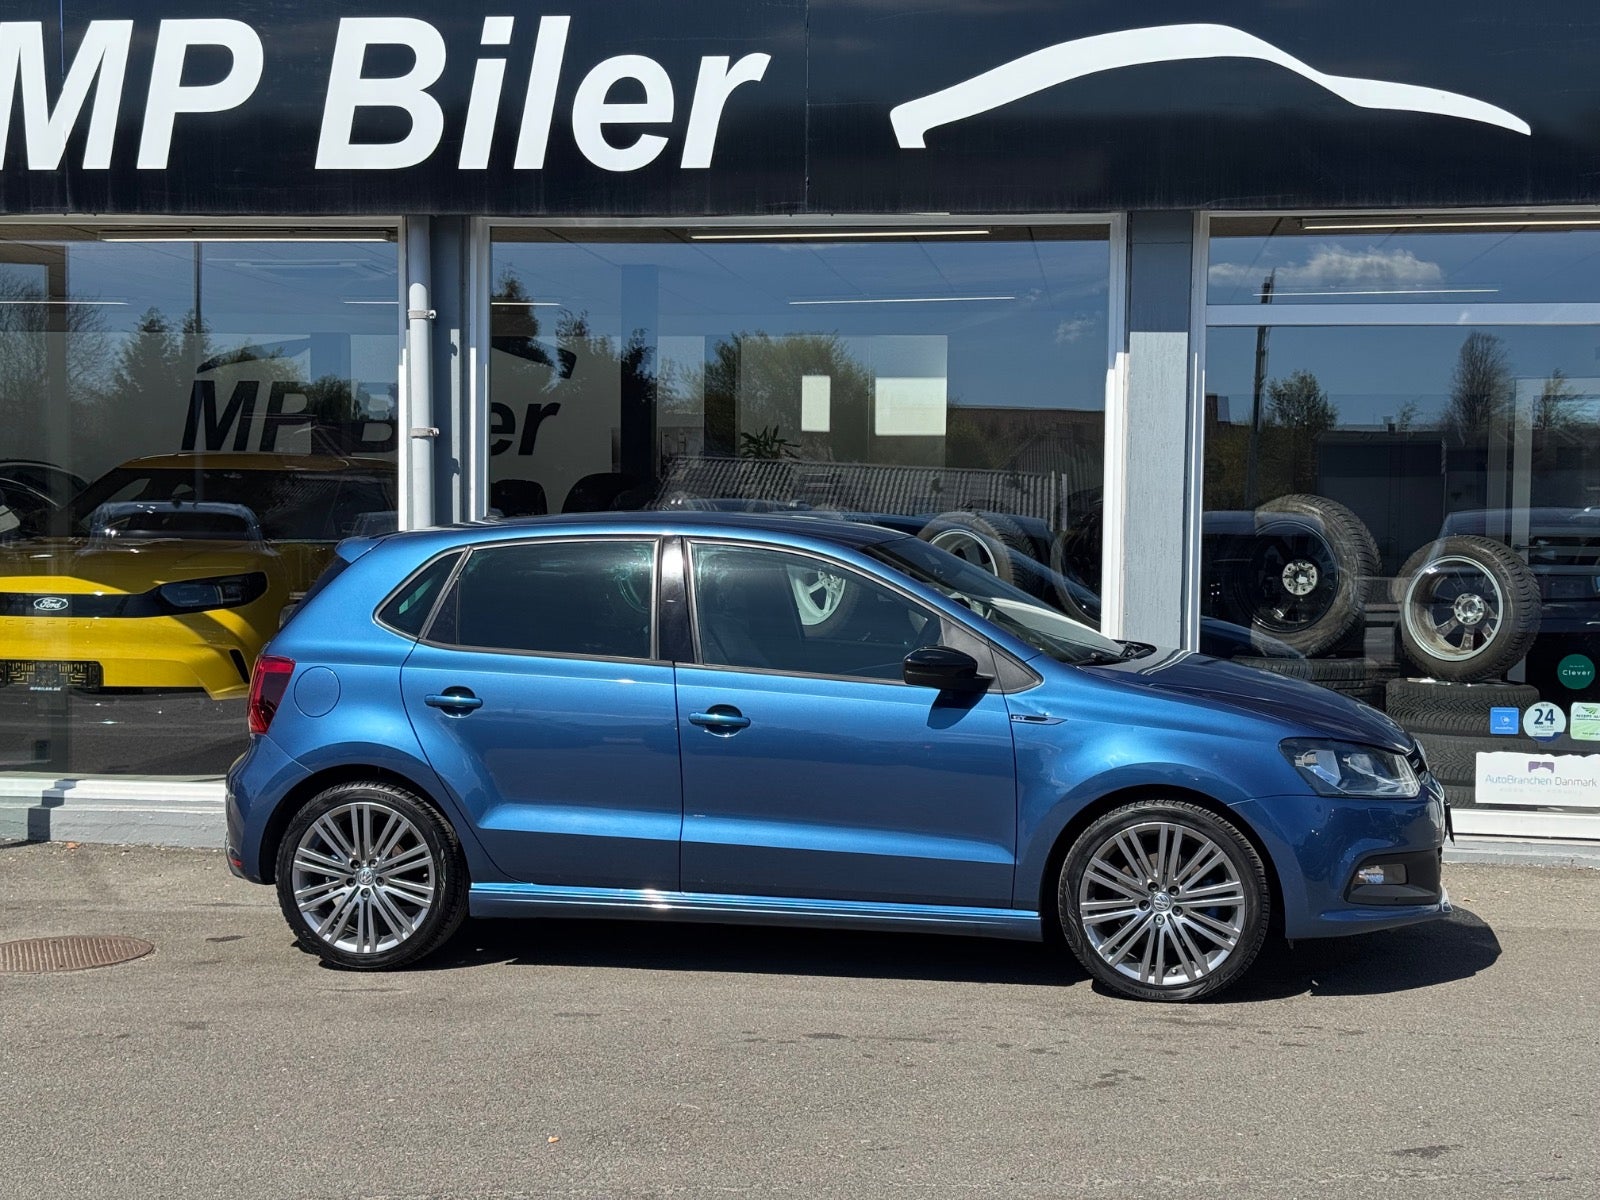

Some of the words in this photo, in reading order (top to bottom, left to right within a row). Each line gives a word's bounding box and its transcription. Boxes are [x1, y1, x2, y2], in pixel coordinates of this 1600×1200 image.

[0, 19, 264, 170] MP
[314, 15, 771, 172] Biler
[40, 599, 62, 608] Ford
[1533, 708, 1556, 726] 24
[1485, 774, 1552, 786] AutoBranchen
[1554, 776, 1598, 787] Danmark
